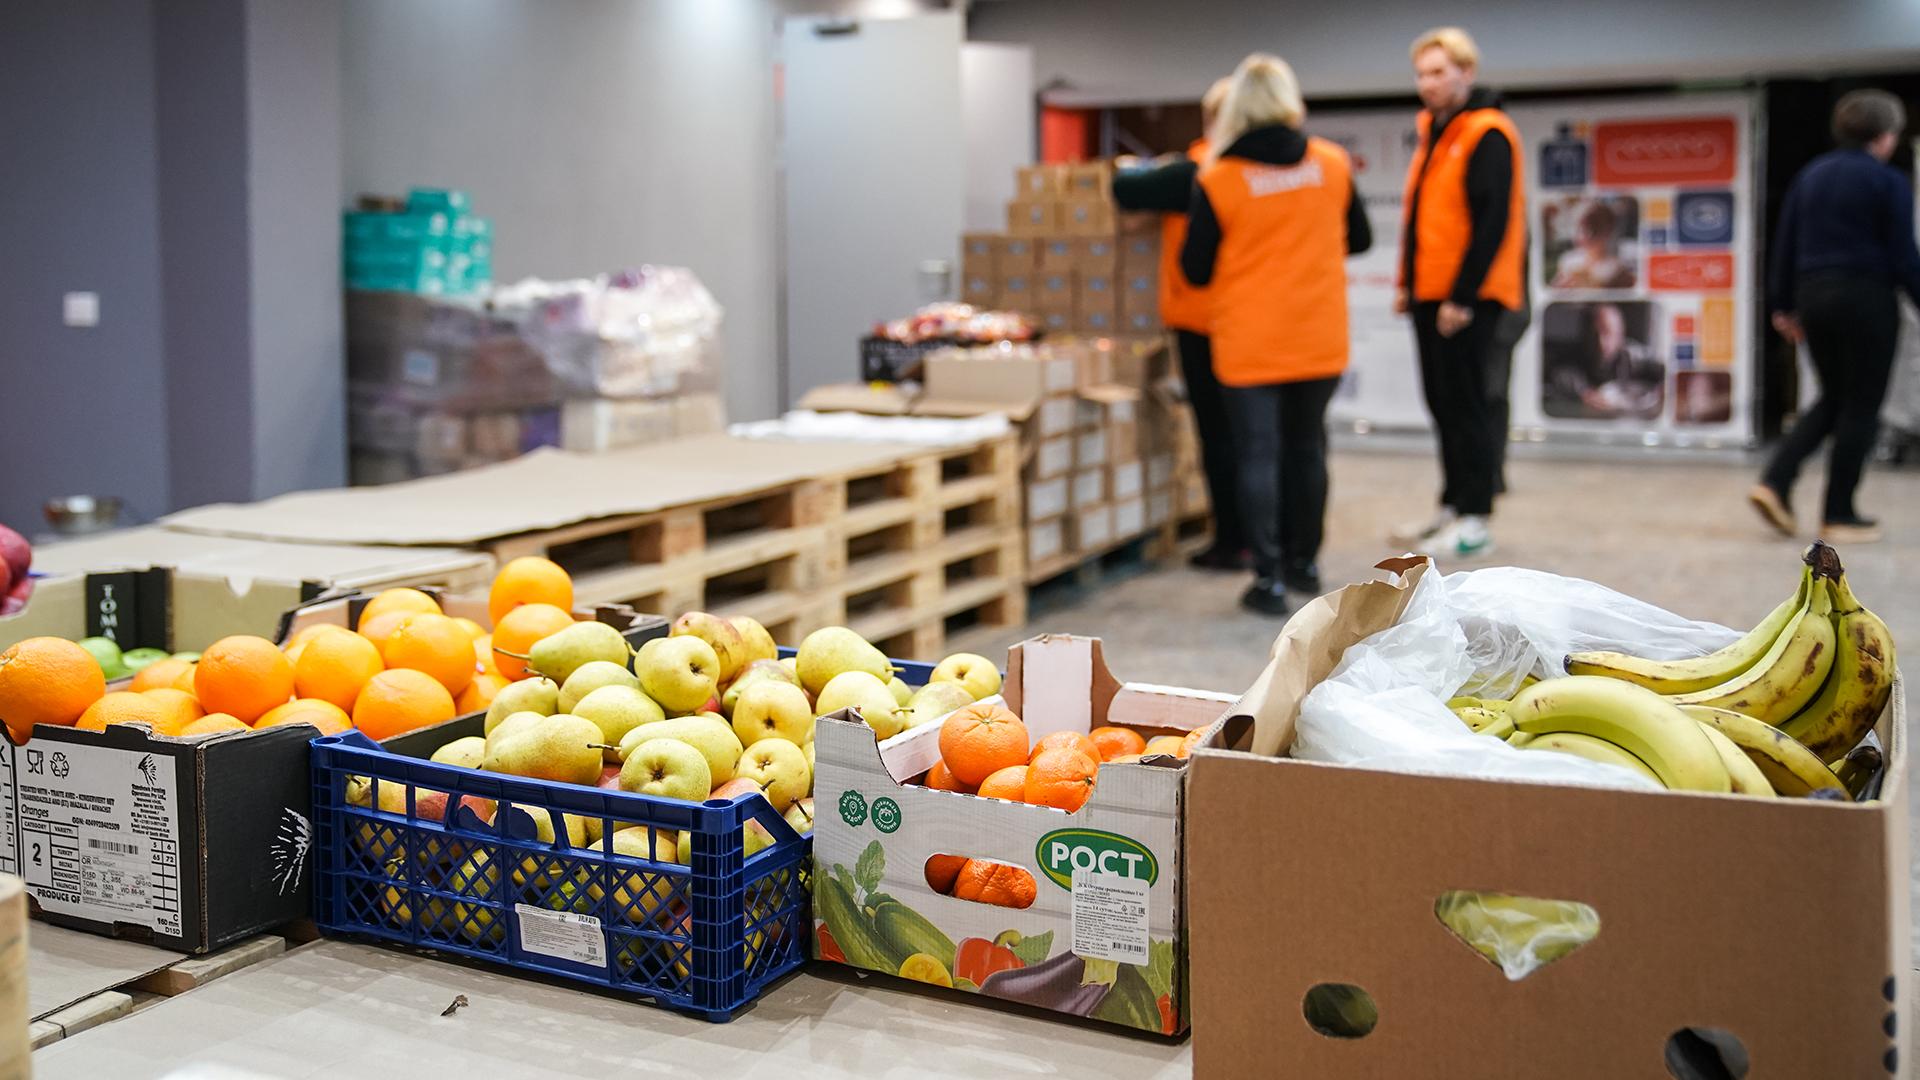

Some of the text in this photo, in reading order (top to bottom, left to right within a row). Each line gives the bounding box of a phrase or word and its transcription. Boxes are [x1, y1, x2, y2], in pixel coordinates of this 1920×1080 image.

[21, 804, 49, 818] Oranges
[24, 821, 47, 830] CATEGORY
[32, 842, 41, 863] 2
[81, 856, 91, 865] OR
[1051, 841, 1143, 880] РОСТ
[55, 882, 78, 891] VALENCIAS
[37, 888, 70, 902] PRODUCE
[71, 894, 80, 904] OF
